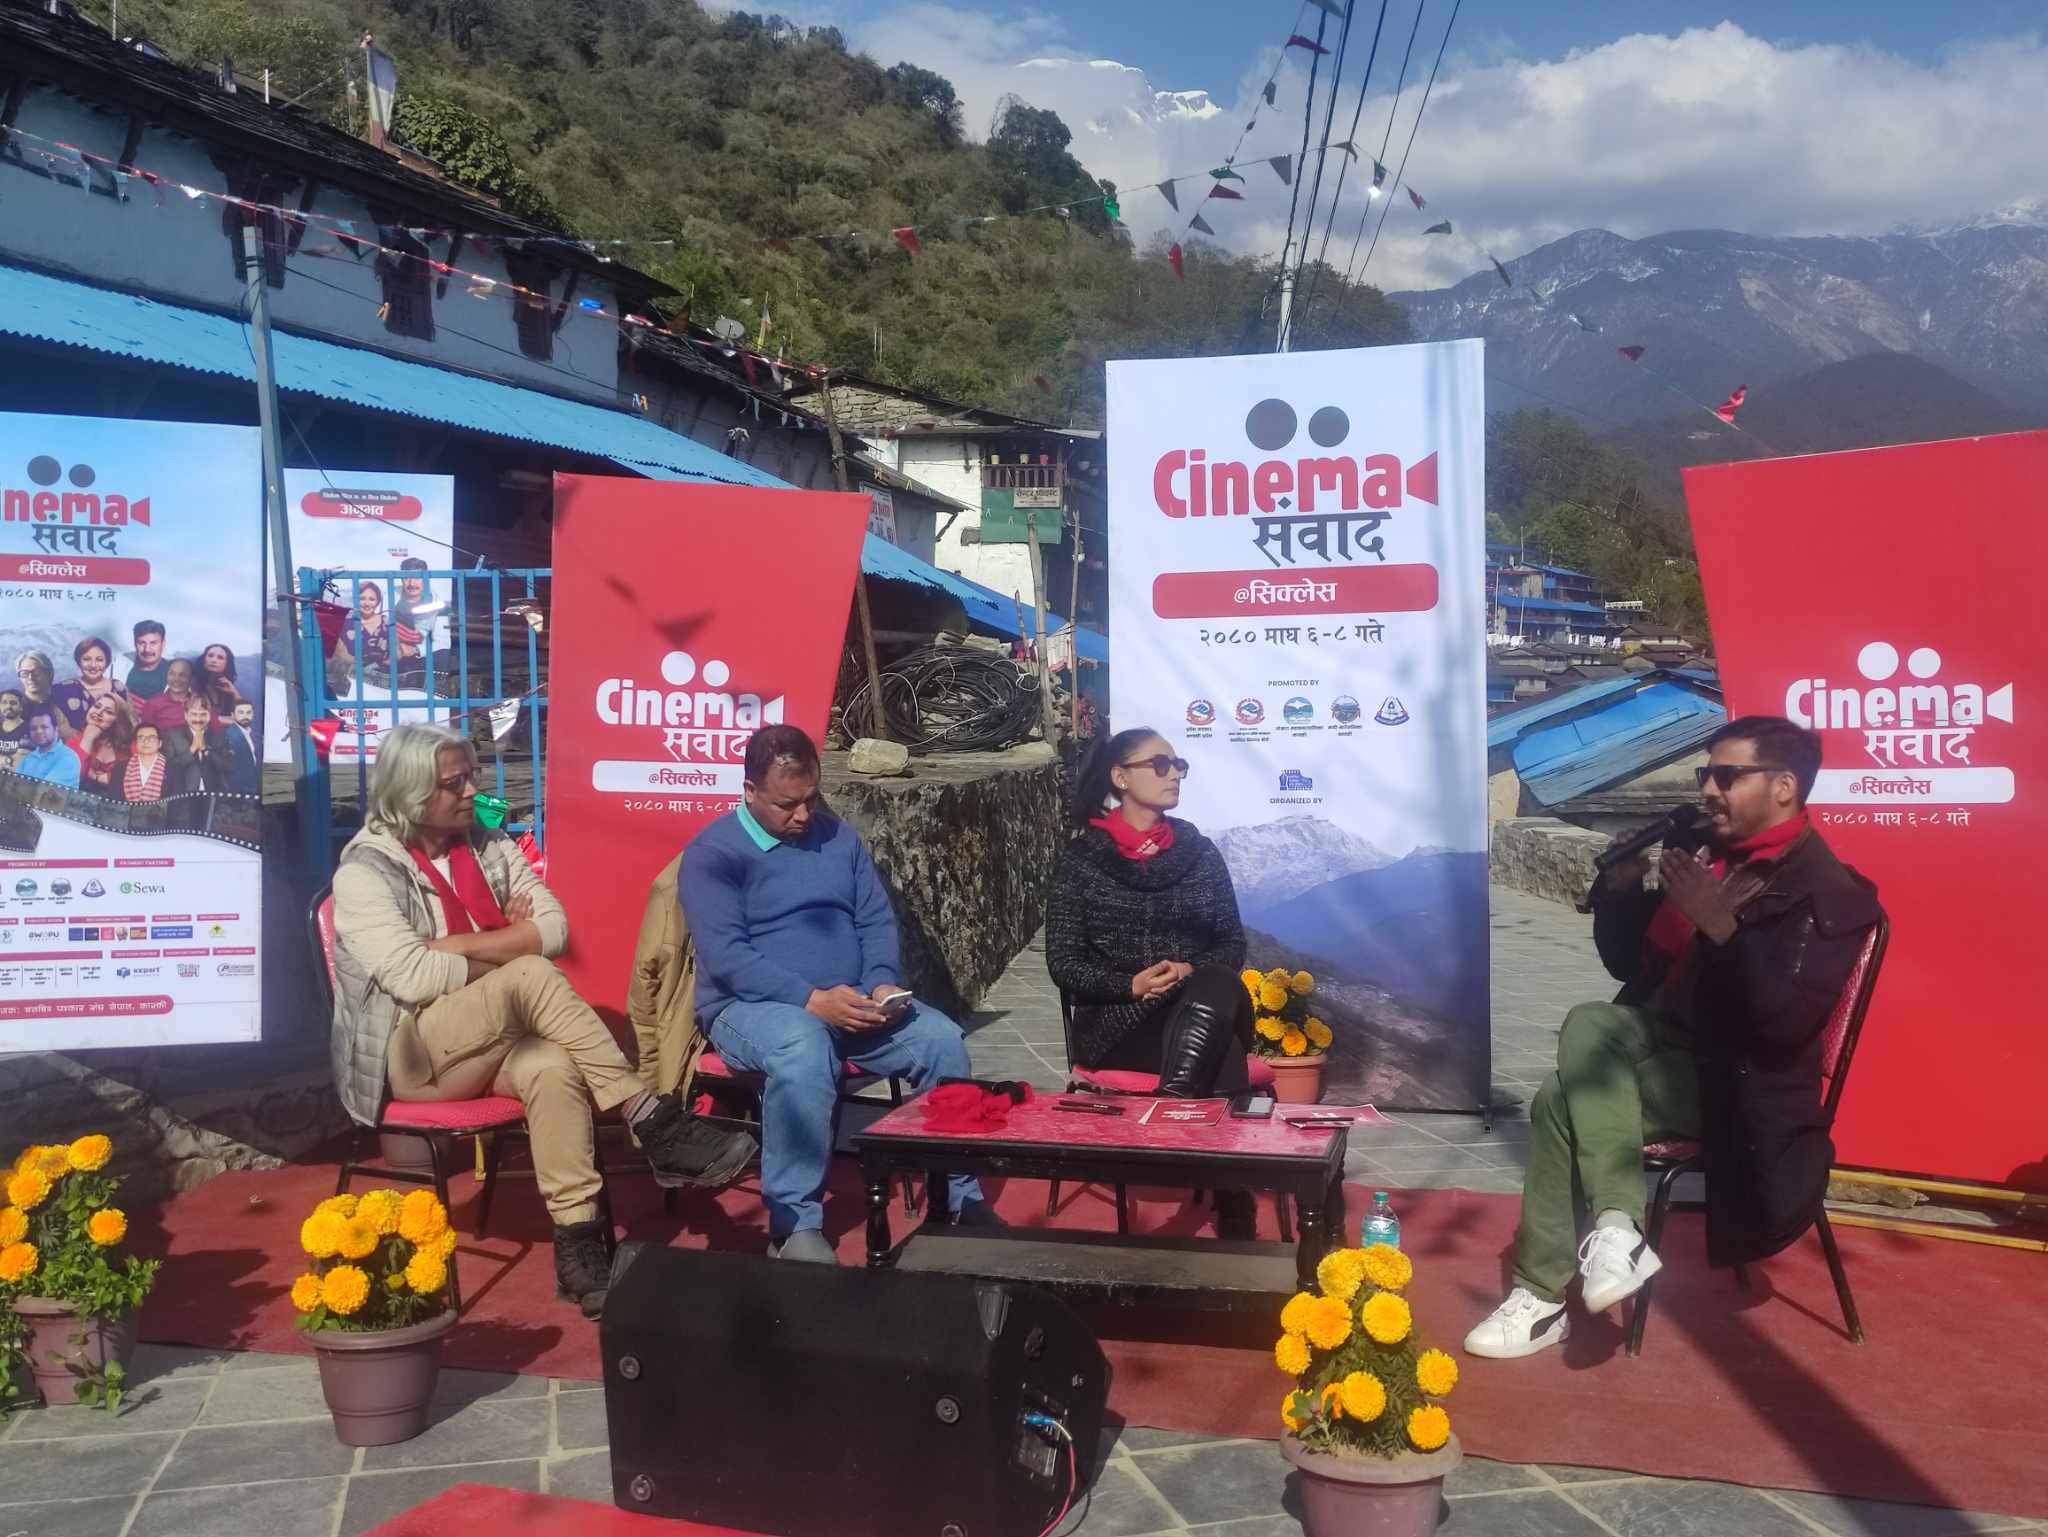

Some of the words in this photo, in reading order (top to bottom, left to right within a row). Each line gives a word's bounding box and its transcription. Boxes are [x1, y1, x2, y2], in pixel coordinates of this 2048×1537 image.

[1153, 449, 1402, 518] Cinema
[0, 489, 128, 526] nema
[31, 513, 122, 555] संवाद
[1252, 496, 1392, 567] संवाद
[1234, 579, 1338, 608] @सिक्लेस
[1200, 628, 1257, 646] २०८०
[1264, 627, 1301, 646] माघ
[1355, 618, 1385, 645] गते
[596, 678, 761, 729] Cinema
[1785, 678, 1984, 729] Cinema
[1863, 714, 1976, 768] संवाद
[648, 768, 717, 787] @सिक्लेस
[1849, 776, 1932, 795] @सिक्लेस
[624, 799, 663, 811] २०८०
[668, 799, 692, 813] माघ
[1313, 797, 1323, 805] BY
[1822, 811, 1867, 826] २०८०
[1872, 811, 1903, 826] माघ
[1947, 808, 1971, 826] गते
